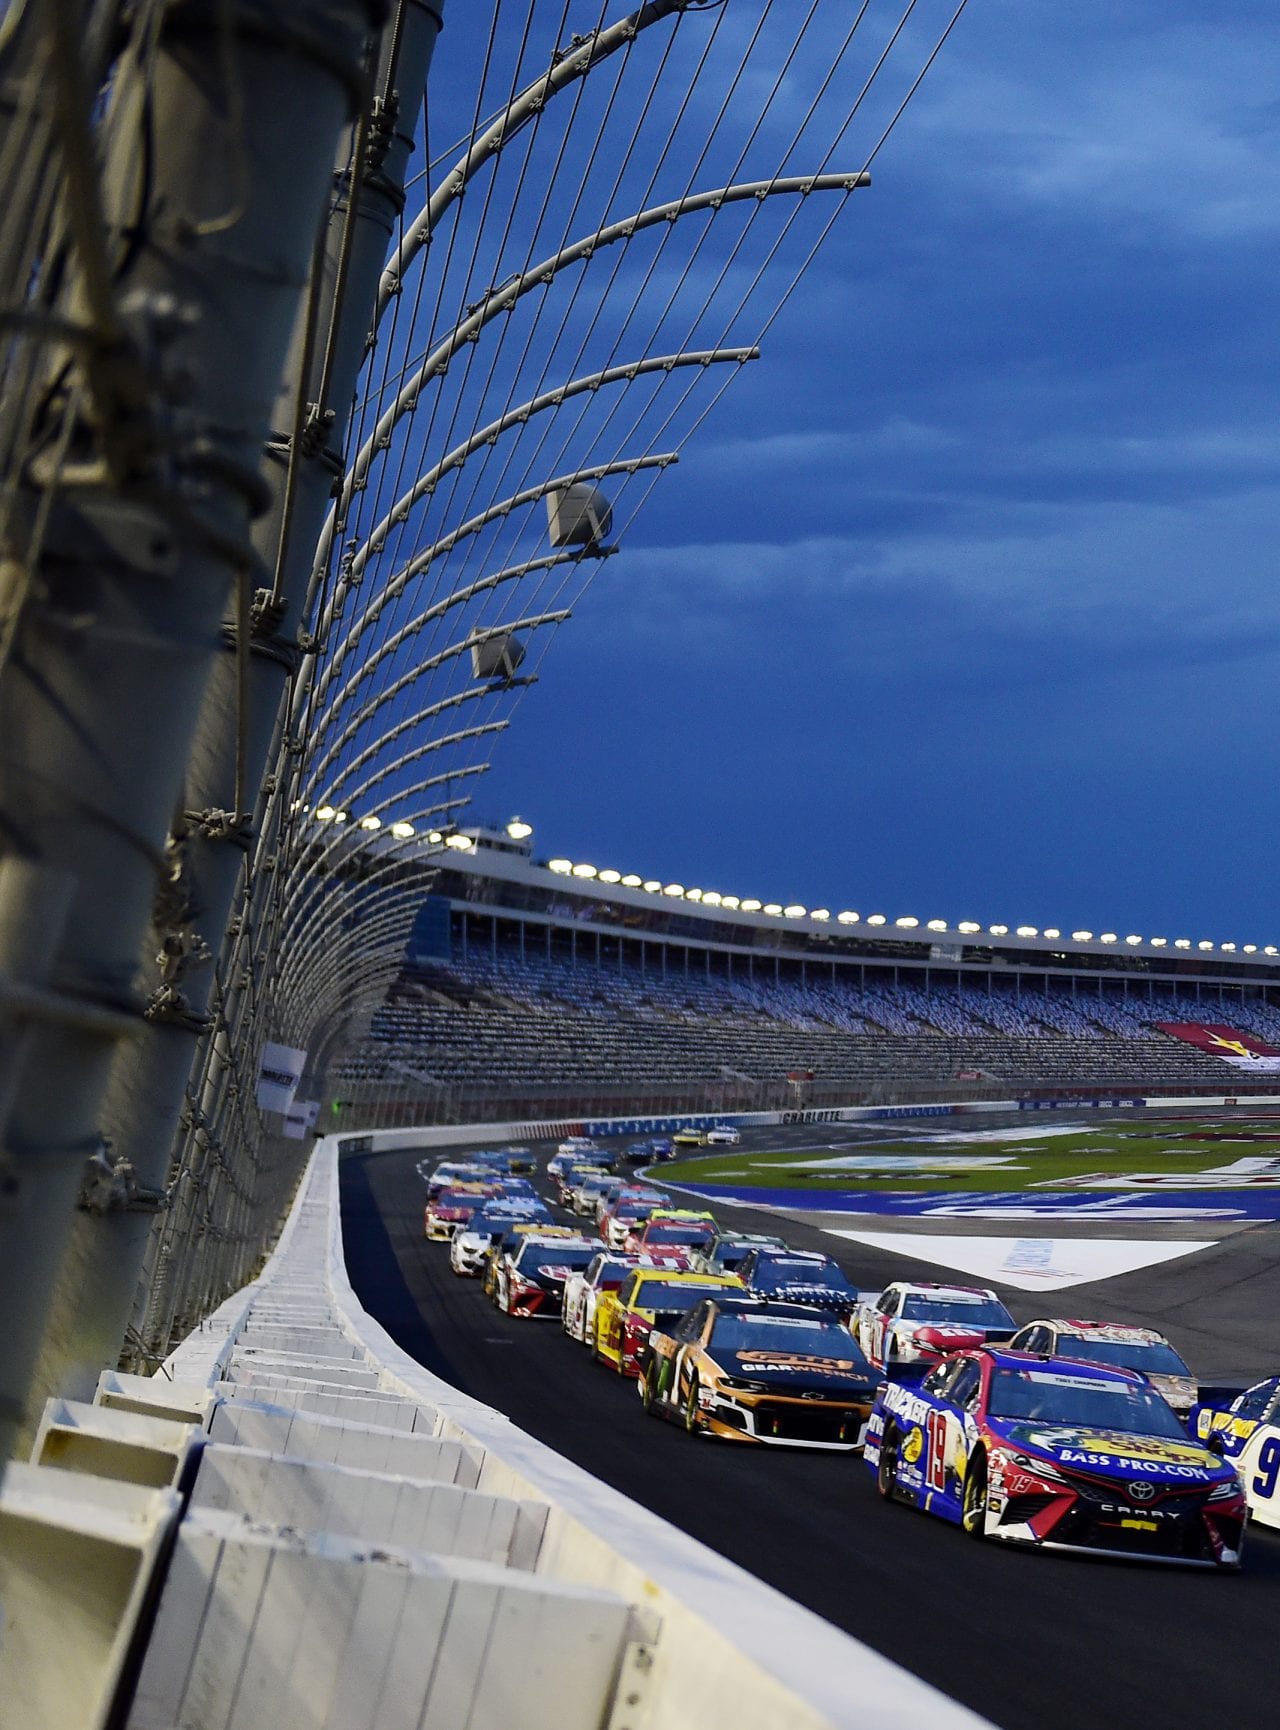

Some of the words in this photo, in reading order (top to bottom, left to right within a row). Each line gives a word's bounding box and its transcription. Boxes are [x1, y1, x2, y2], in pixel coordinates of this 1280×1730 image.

[782, 1110, 841, 1123] CHARLOTTE
[883, 1382, 932, 1426] TRACKER
[926, 1409, 947, 1493] 19
[1060, 1449, 1111, 1466] BASS
[1100, 1503, 1181, 1520] CAMRY
